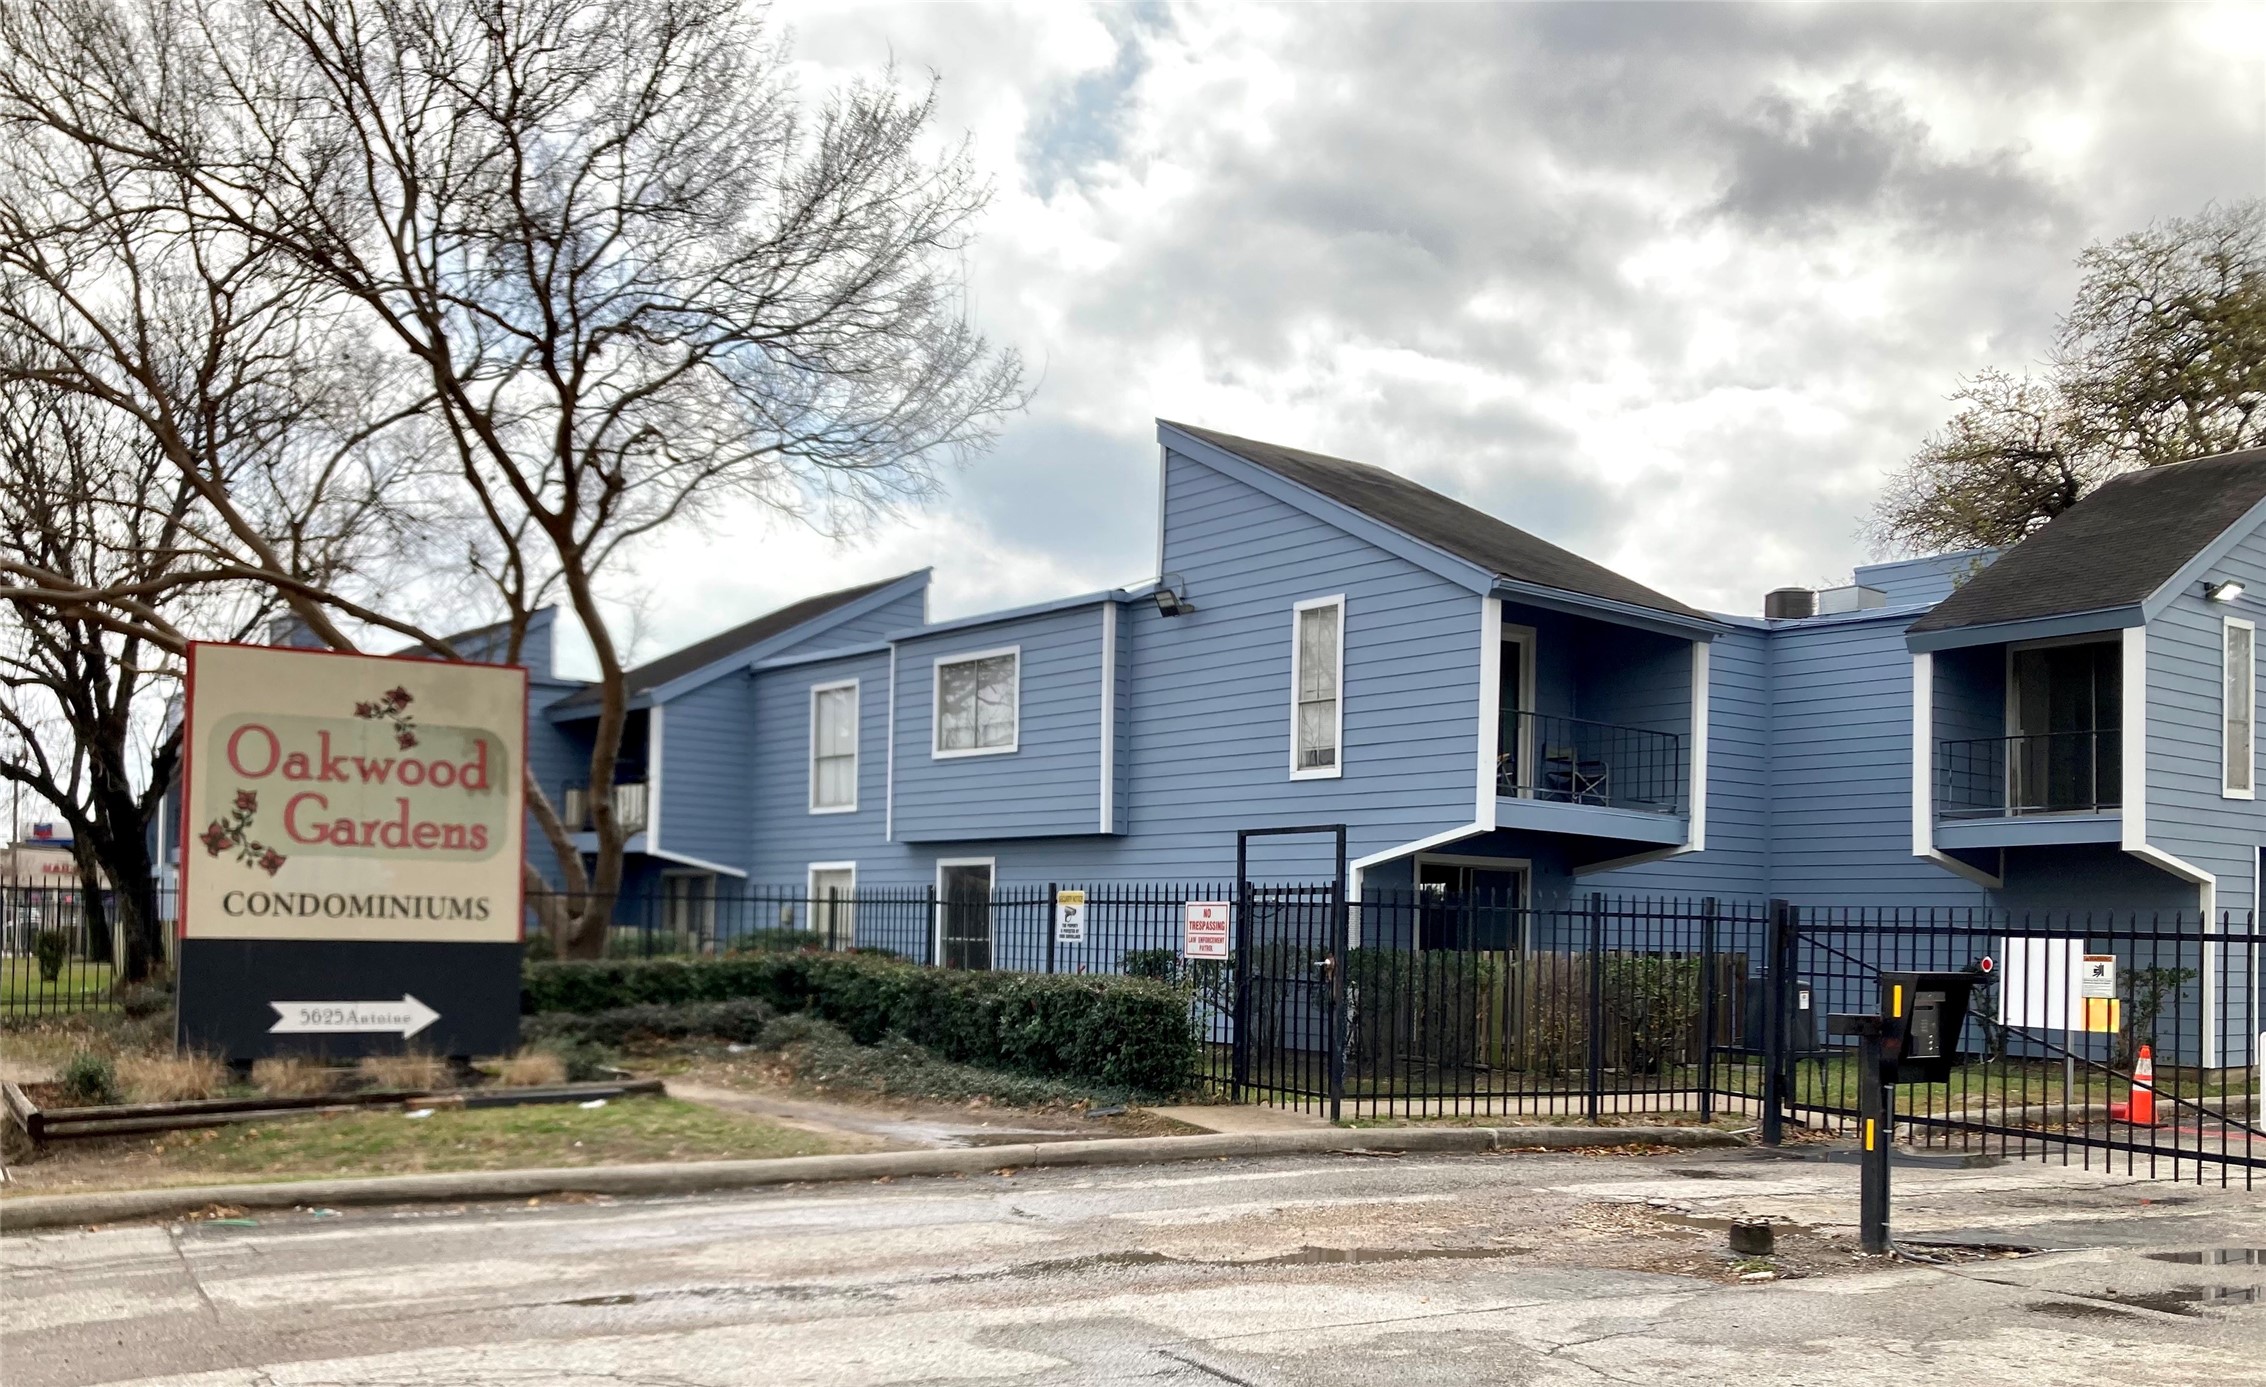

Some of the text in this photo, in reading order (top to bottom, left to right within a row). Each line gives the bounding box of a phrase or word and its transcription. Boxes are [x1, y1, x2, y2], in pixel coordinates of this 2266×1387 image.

[226, 723, 489, 790] Oakwood
[284, 792, 489, 851] Gardens
[223, 891, 490, 921] CONDOMINIUMS
[1203, 908, 1212, 918] NO
[1189, 921, 1225, 931] TRESPASSING
[300, 1008, 344, 1025] 5625
